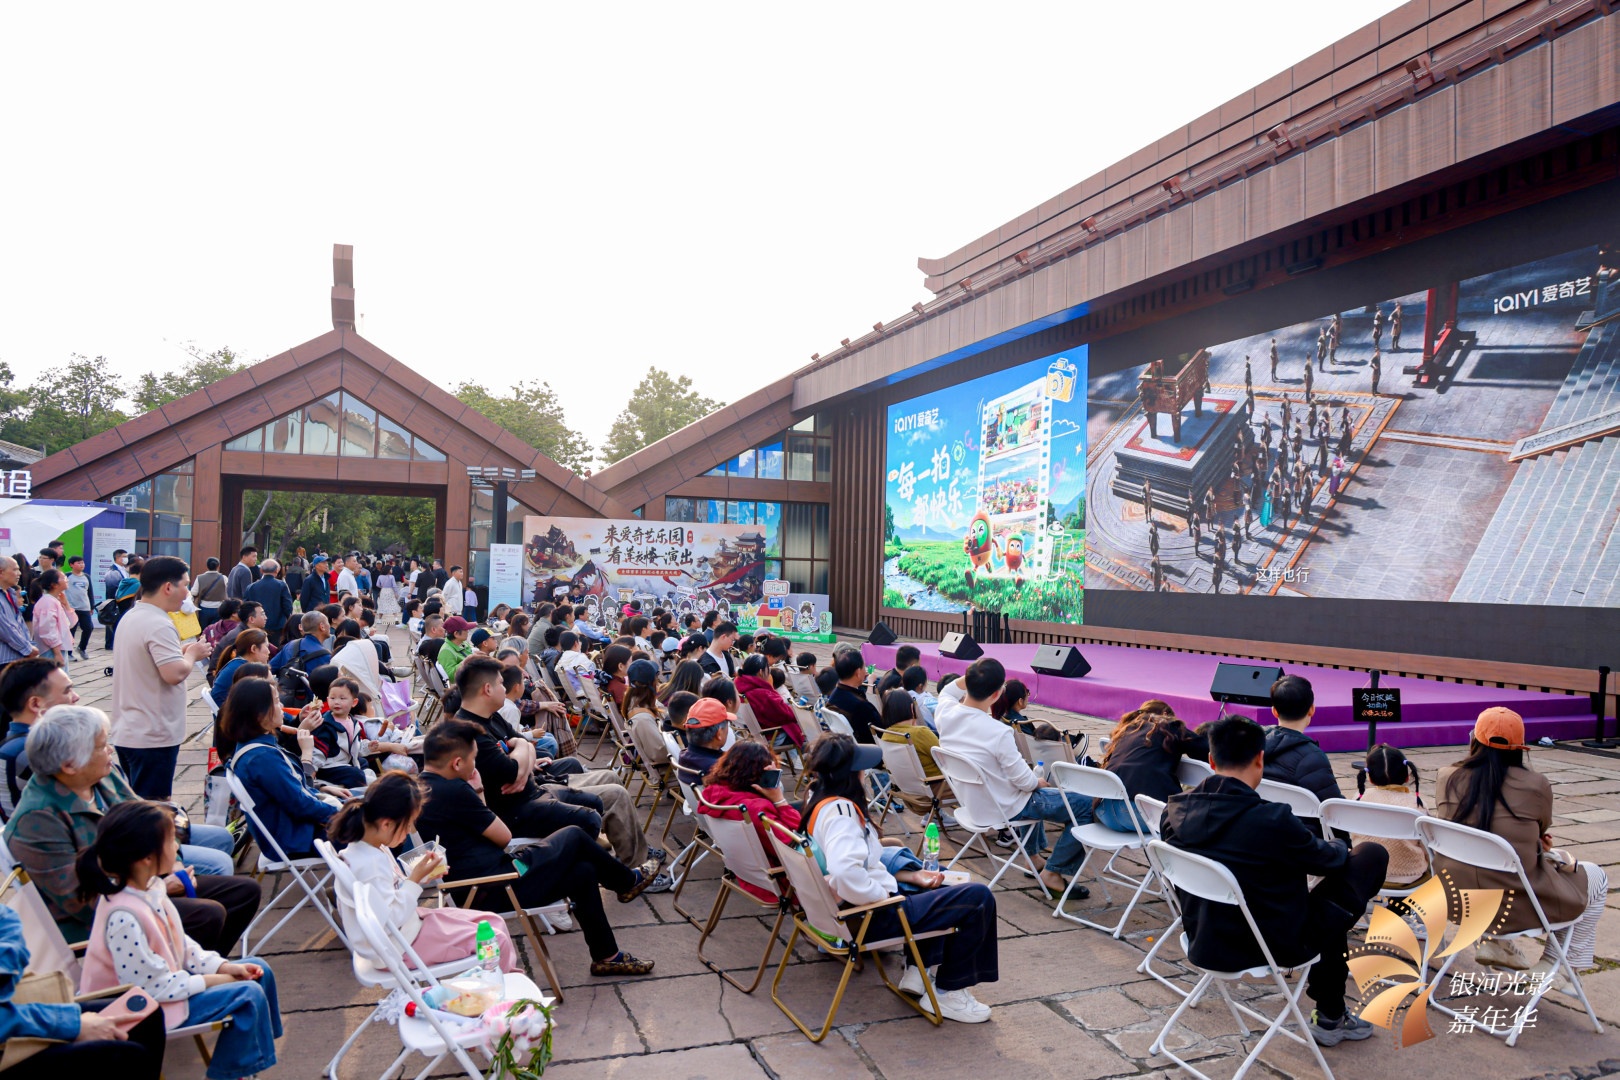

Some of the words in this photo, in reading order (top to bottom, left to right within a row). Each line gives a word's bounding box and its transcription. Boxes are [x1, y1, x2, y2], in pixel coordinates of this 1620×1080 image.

[1493, 288, 1539, 315] iQIYI
[1542, 276, 1592, 303] 爱奇艺
[894, 413, 917, 434] iQIYI
[917, 407, 939, 428] 爱奇艺
[912, 476, 963, 535] 都快乐
[602, 524, 684, 547] 来爱奇艺乐园
[1255, 566, 1310, 583] 这样也行
